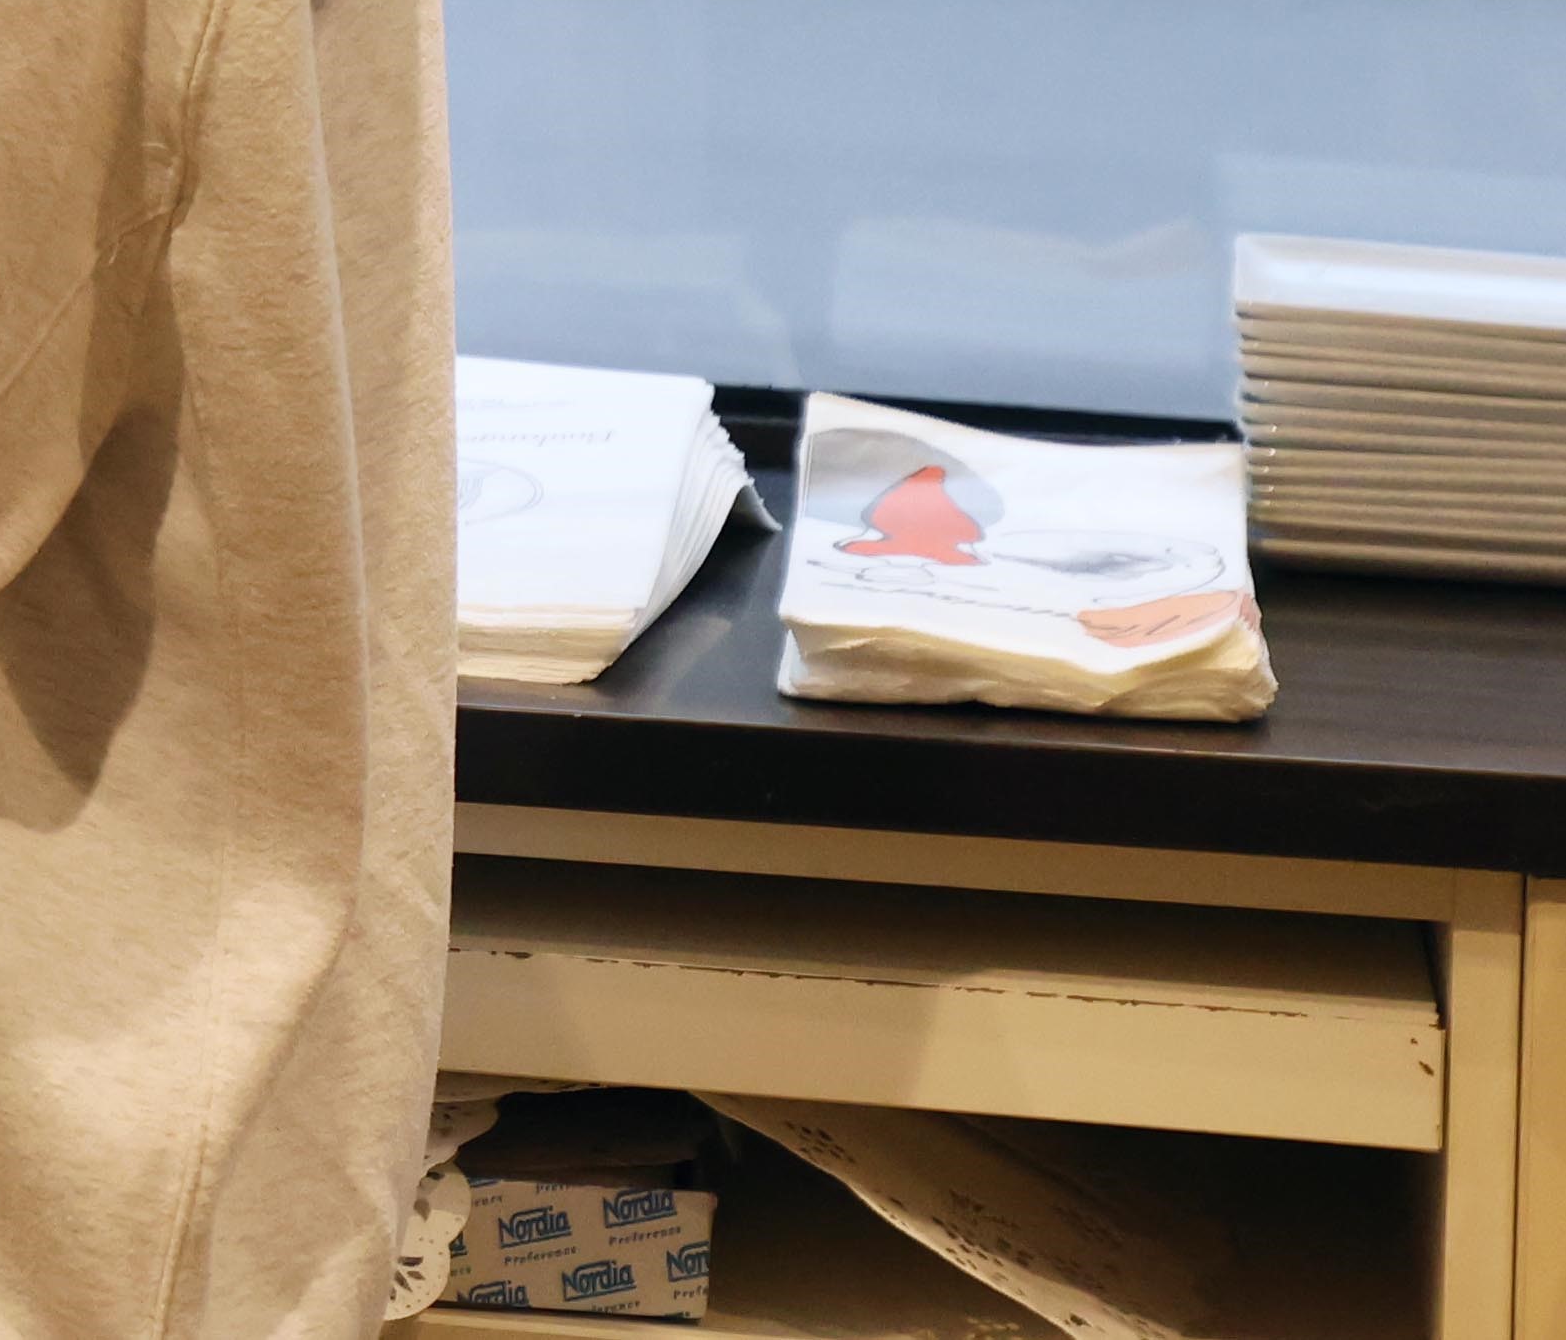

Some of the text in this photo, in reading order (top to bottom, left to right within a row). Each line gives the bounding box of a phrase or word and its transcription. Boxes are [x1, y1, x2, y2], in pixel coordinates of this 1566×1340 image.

[498, 1205, 572, 1249] Nordia
[603, 1187, 678, 1229] Nordia
[562, 1259, 637, 1302] Nordia
[666, 1240, 710, 1282] Nor
